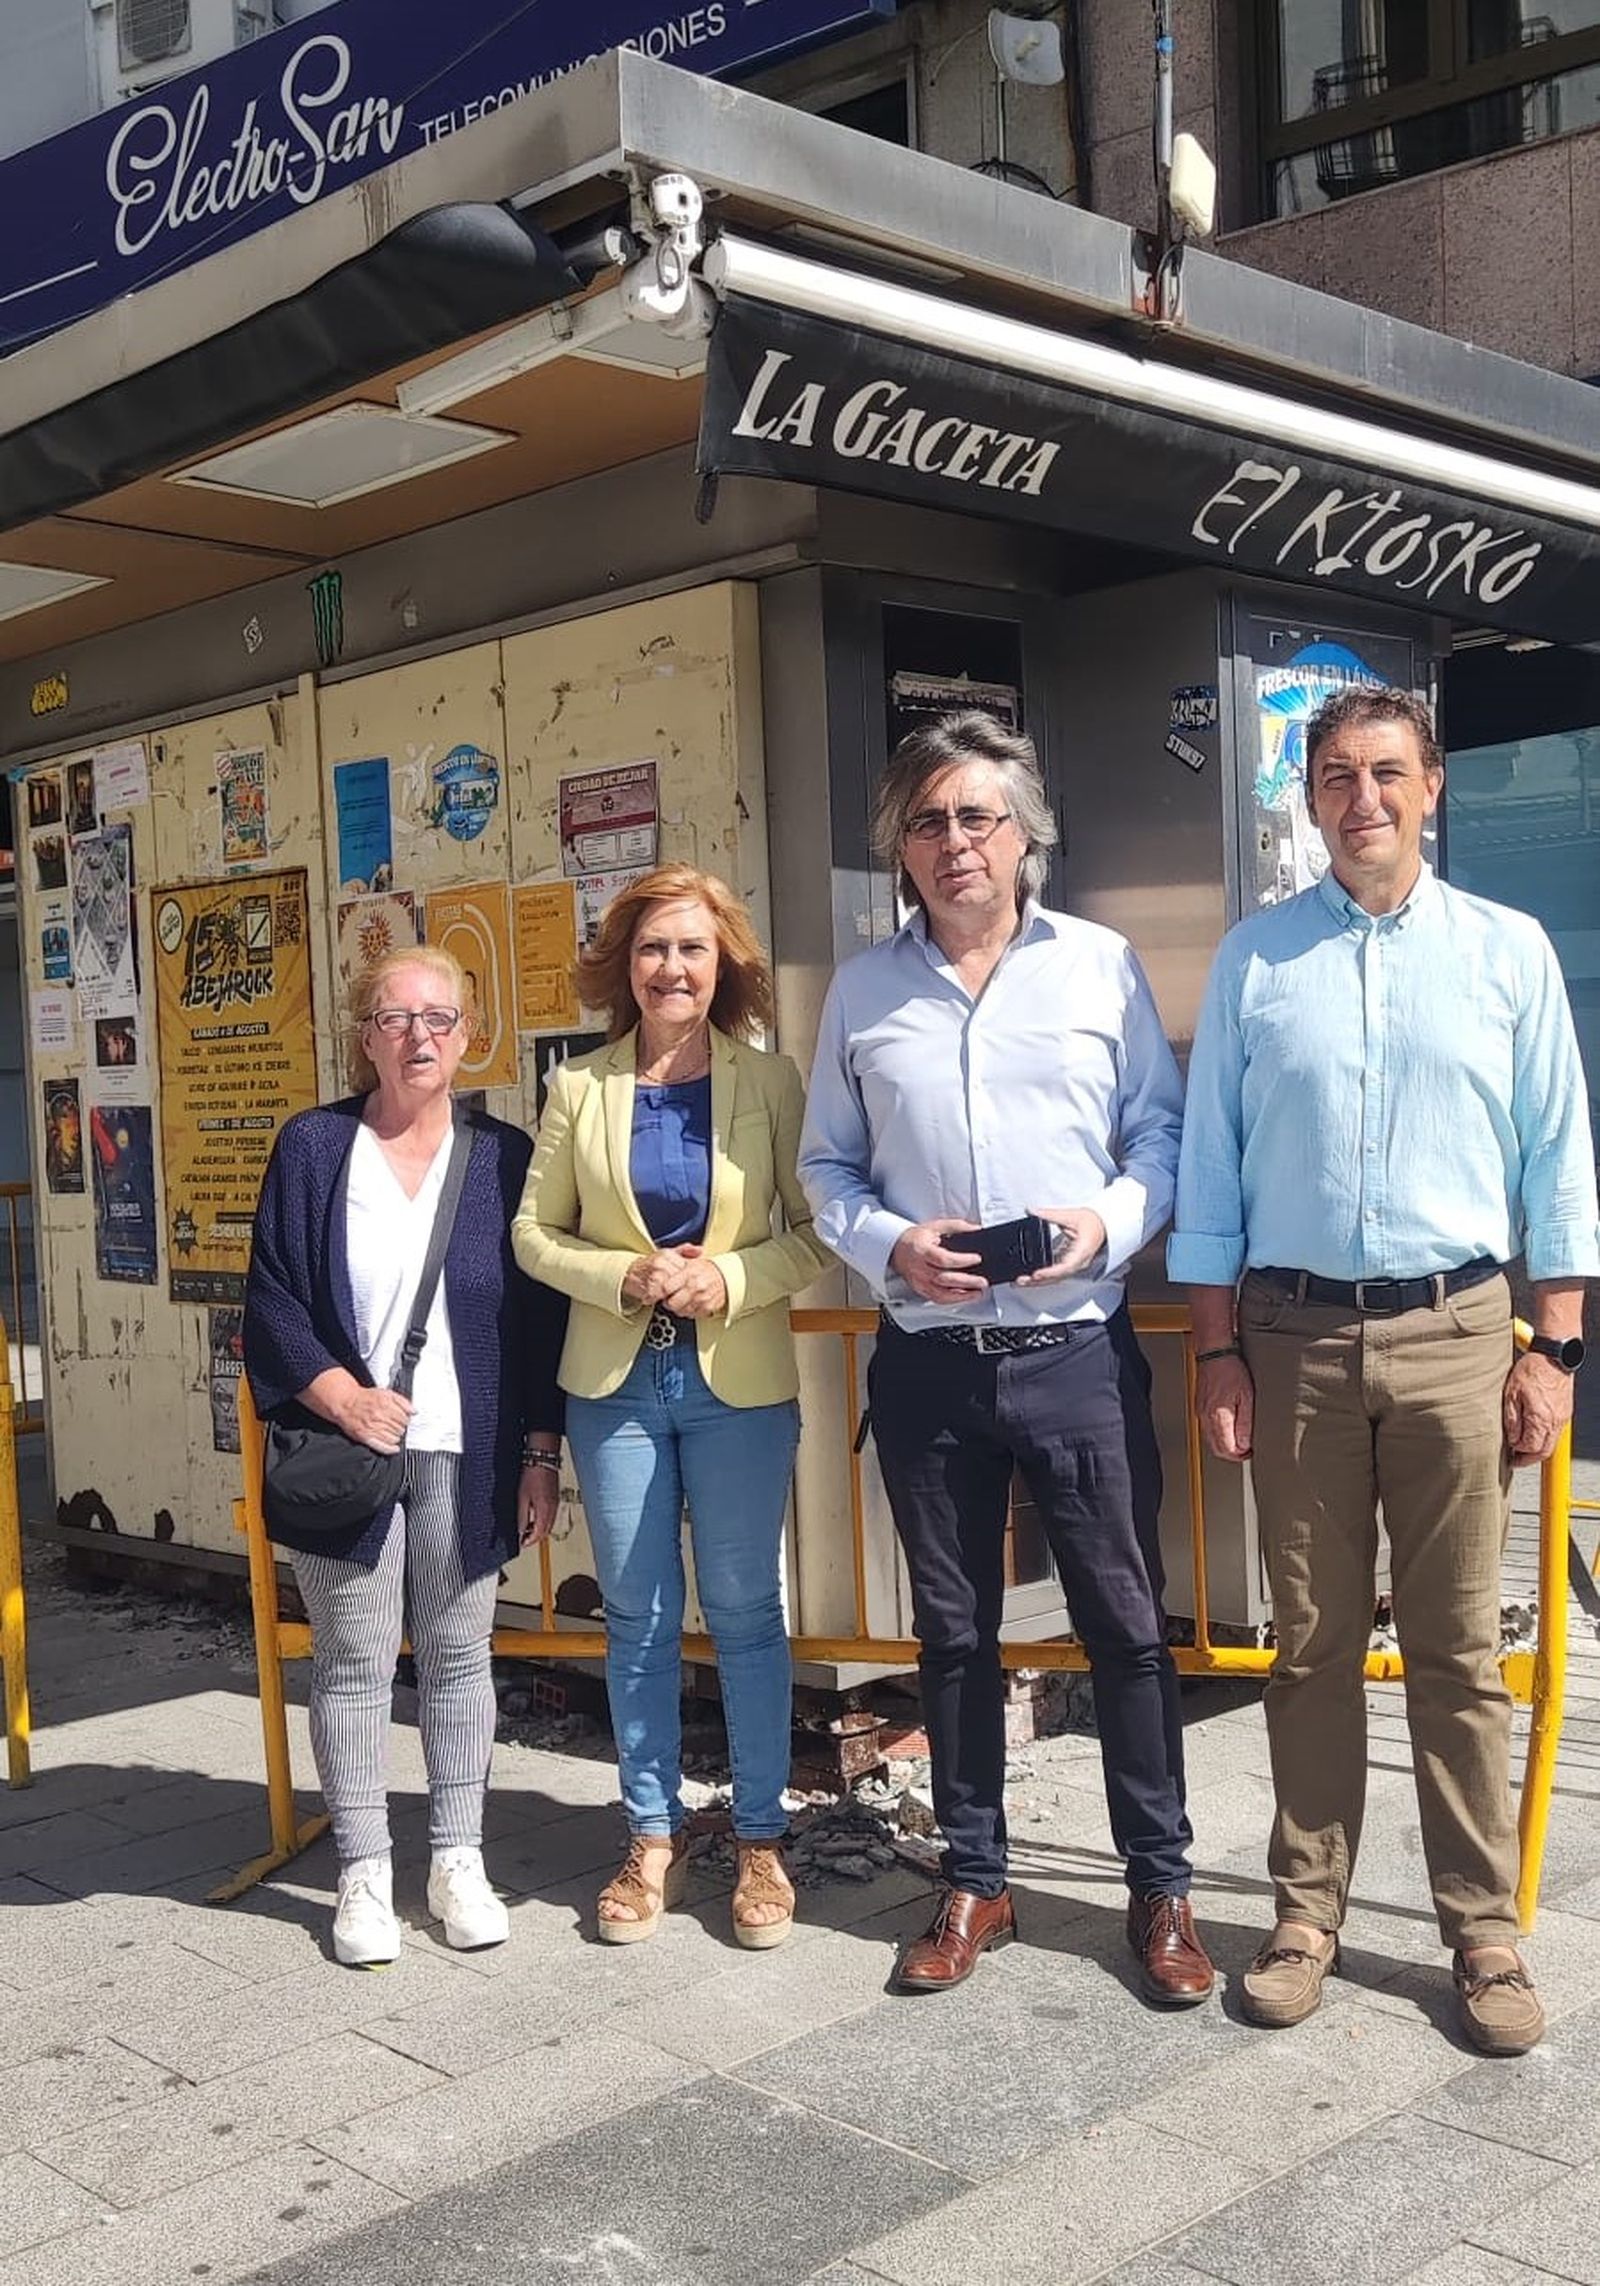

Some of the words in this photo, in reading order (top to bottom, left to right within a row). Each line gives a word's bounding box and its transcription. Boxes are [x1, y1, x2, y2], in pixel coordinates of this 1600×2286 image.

[732, 349, 826, 447] LA
[832, 379, 1061, 496] GACETA
[1256, 663, 1319, 698] FRESCOR
[1323, 664, 1344, 689] EN
[180, 967, 274, 1013] ABEJAROCK
